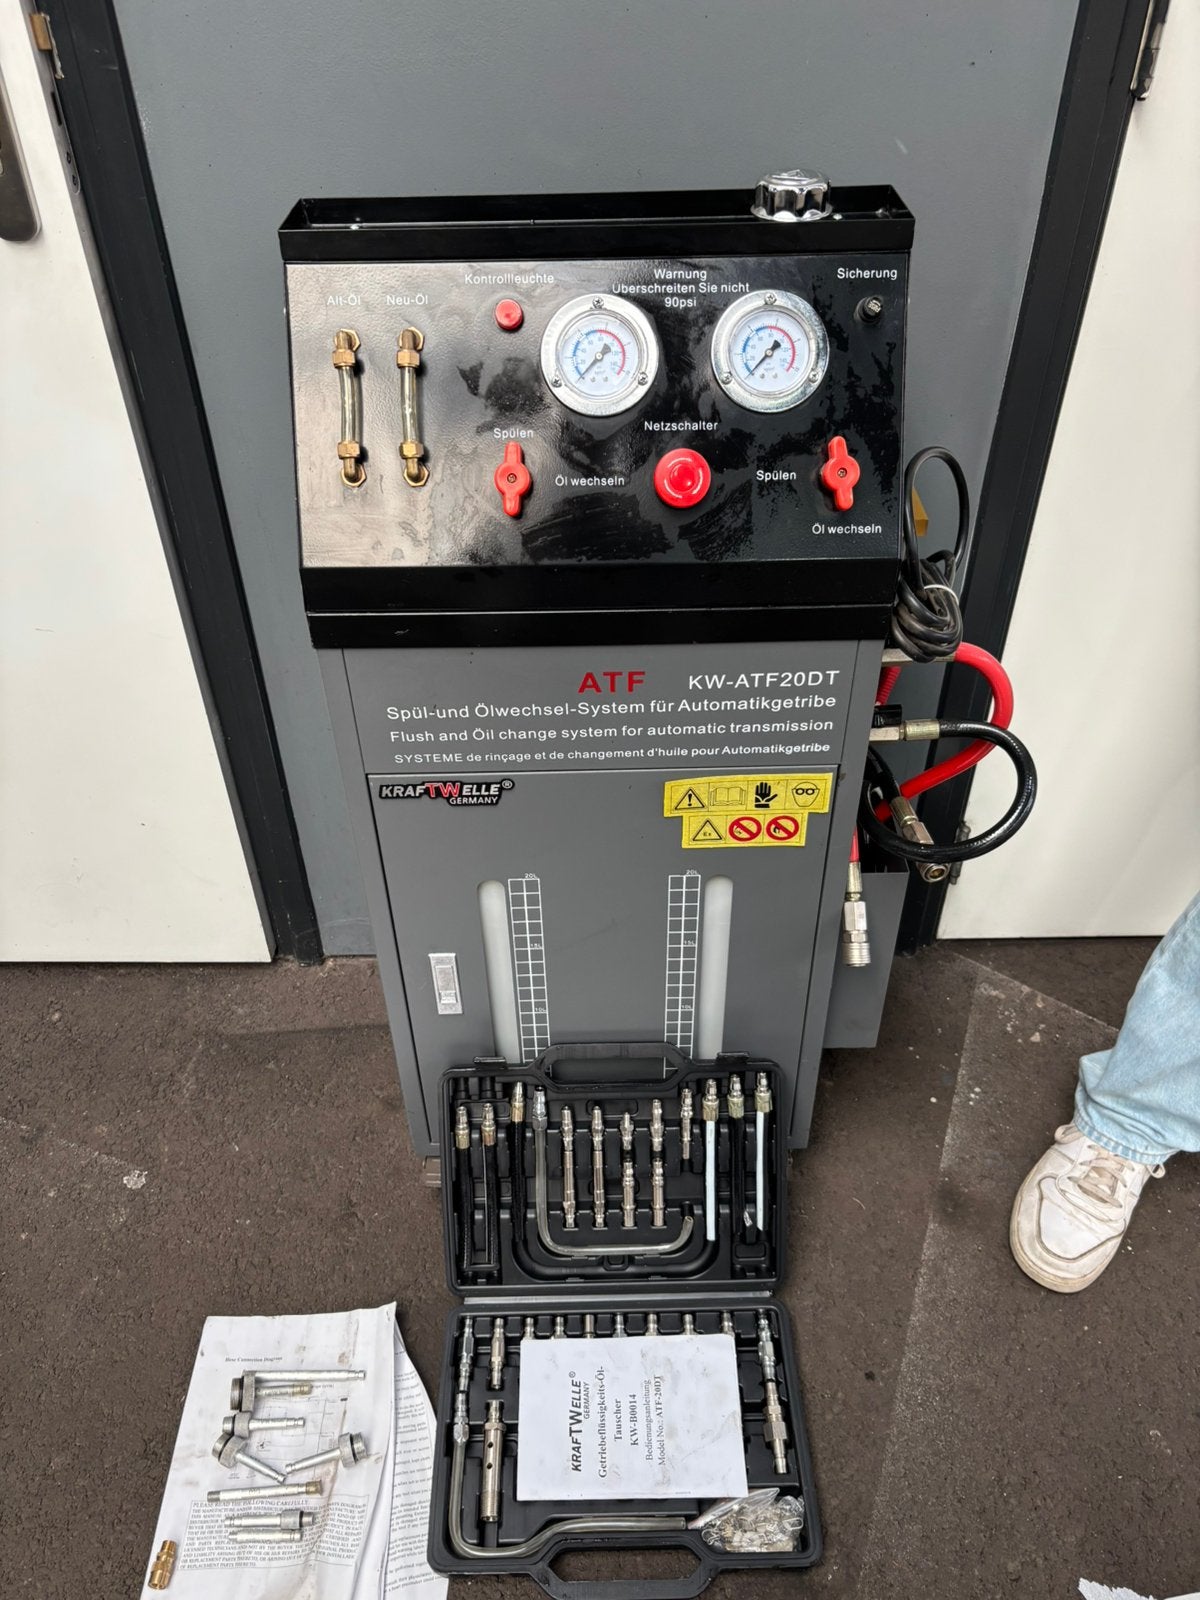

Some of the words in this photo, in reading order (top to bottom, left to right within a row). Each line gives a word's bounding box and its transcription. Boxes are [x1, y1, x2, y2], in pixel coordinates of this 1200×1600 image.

[464, 273, 554, 285] Kontrollleuchte
[654, 269, 707, 281] Warnung
[837, 268, 897, 280] Sicherung
[698, 282, 718, 293] Sie
[721, 282, 750, 292] nicht
[327, 294, 361, 306] Alt-Öl
[386, 293, 428, 305] Neu-Öl
[665, 297, 696, 309] 90psi
[644, 420, 718, 431] Netzschalter
[493, 427, 534, 439] Spülen
[555, 474, 568, 486] Öl
[570, 475, 625, 486] wechseln
[756, 470, 796, 482] Spülen
[812, 522, 824, 535] Öl
[827, 523, 882, 534] wechseln
[578, 671, 646, 694] ATF
[688, 670, 840, 690] KW-ATF20DT
[386, 705, 469, 722] Spül-und
[475, 702, 644, 718] Ölwechsel-System
[650, 700, 674, 712] für
[678, 695, 836, 712] Automatikgetribe
[390, 731, 434, 742] Flush
[439, 730, 468, 741] and
[473, 728, 494, 741] Öil
[499, 728, 557, 742] change
[561, 727, 617, 740] system
[622, 726, 643, 737] for
[648, 722, 726, 736] automatic
[730, 720, 833, 734] transmission
[394, 753, 463, 764] SYSTEME
[466, 752, 482, 762] de
[485, 752, 531, 763] rinçage
[534, 752, 546, 760] et
[549, 751, 564, 760] de
[567, 748, 644, 761] changement
[647, 748, 688, 758] d'huile
[692, 748, 719, 758] pour
[722, 743, 830, 756] Automatikgetribe
[449, 796, 498, 805] GERMANY
[614, 1398, 622, 1442] Tauscher
[629, 1394, 638, 1446] KW-B0014
[642, 1379, 654, 1461] Bedienungsanleitung
[656, 1439, 666, 1466] Model
